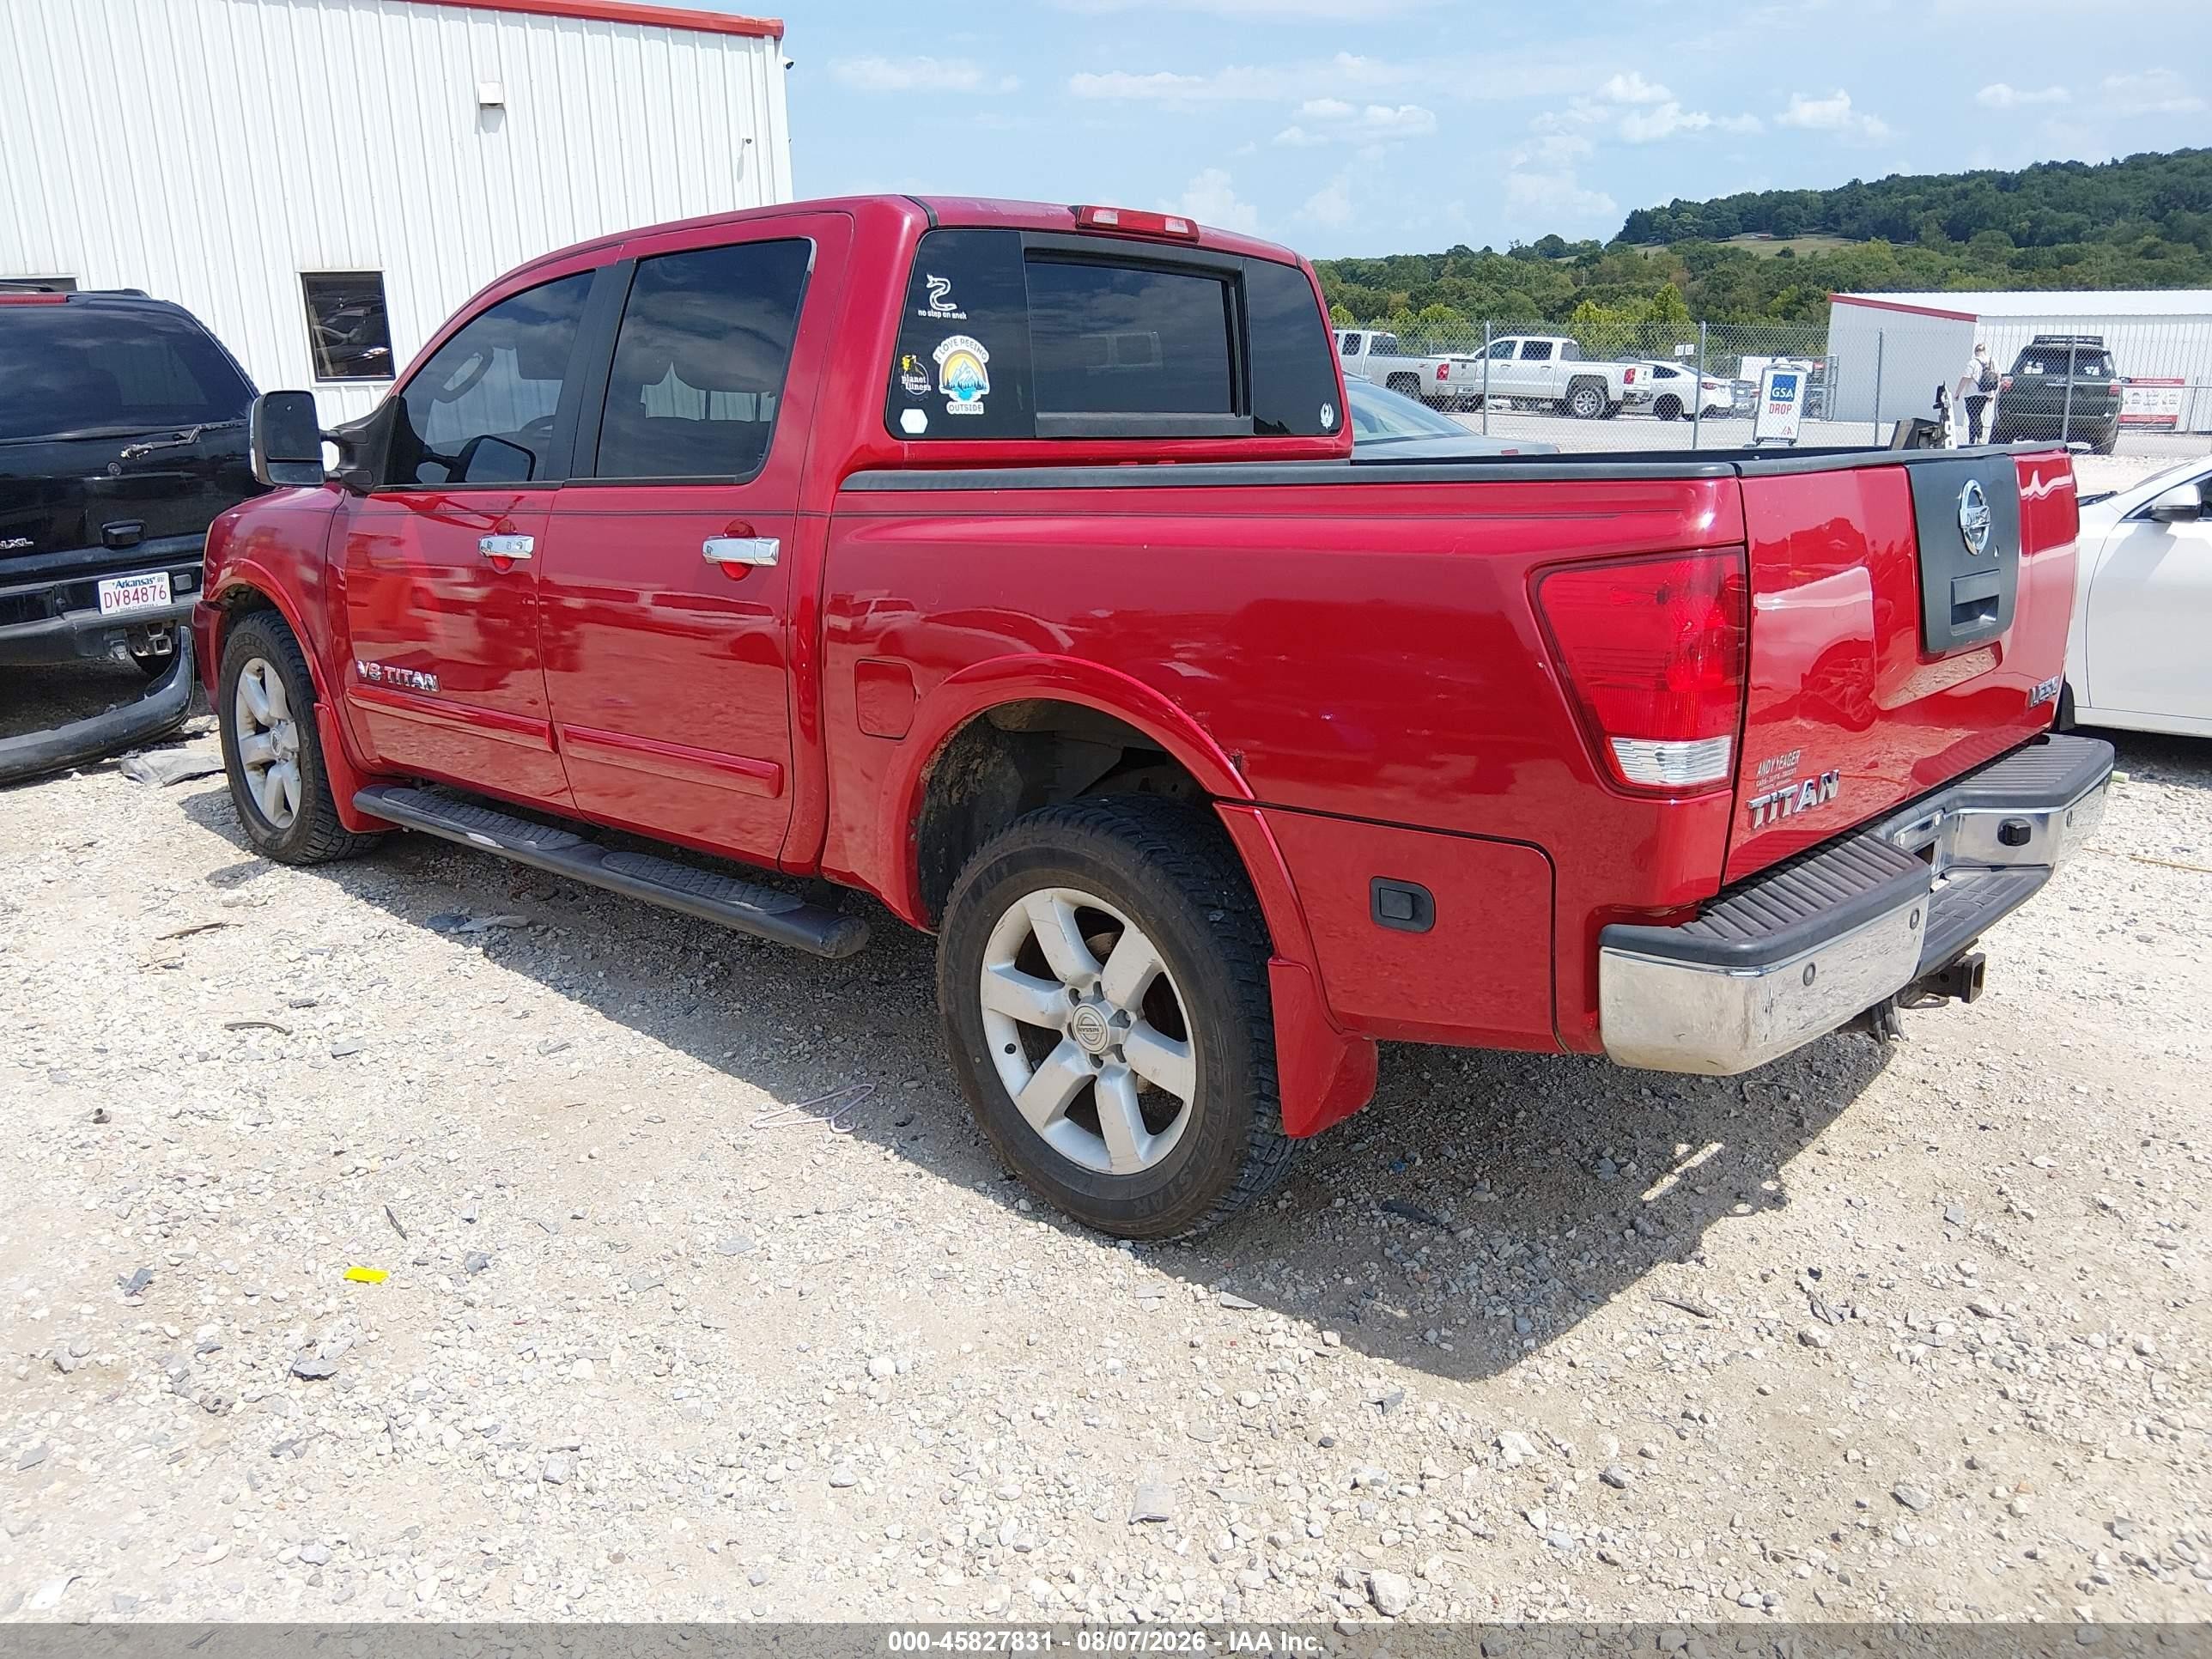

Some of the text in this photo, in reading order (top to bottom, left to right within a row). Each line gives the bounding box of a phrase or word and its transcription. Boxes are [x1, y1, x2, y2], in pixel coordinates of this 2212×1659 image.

[927, 309, 942, 319] step
[939, 337, 958, 356] LOVE
[960, 337, 988, 361] PEEING
[901, 374, 927, 385] planet
[905, 383, 932, 392] fitness
[1771, 387, 1794, 398] GSA
[948, 404, 982, 412] OUTSIDE
[1769, 403, 1792, 415] DROP
[115, 578, 154, 590] Arkansas
[104, 585, 167, 609] DV84876
[357, 659, 441, 692] V8 TITAN
[1755, 750, 1801, 778] ANDY YEAGER
[1746, 769, 1840, 830] TITAN
